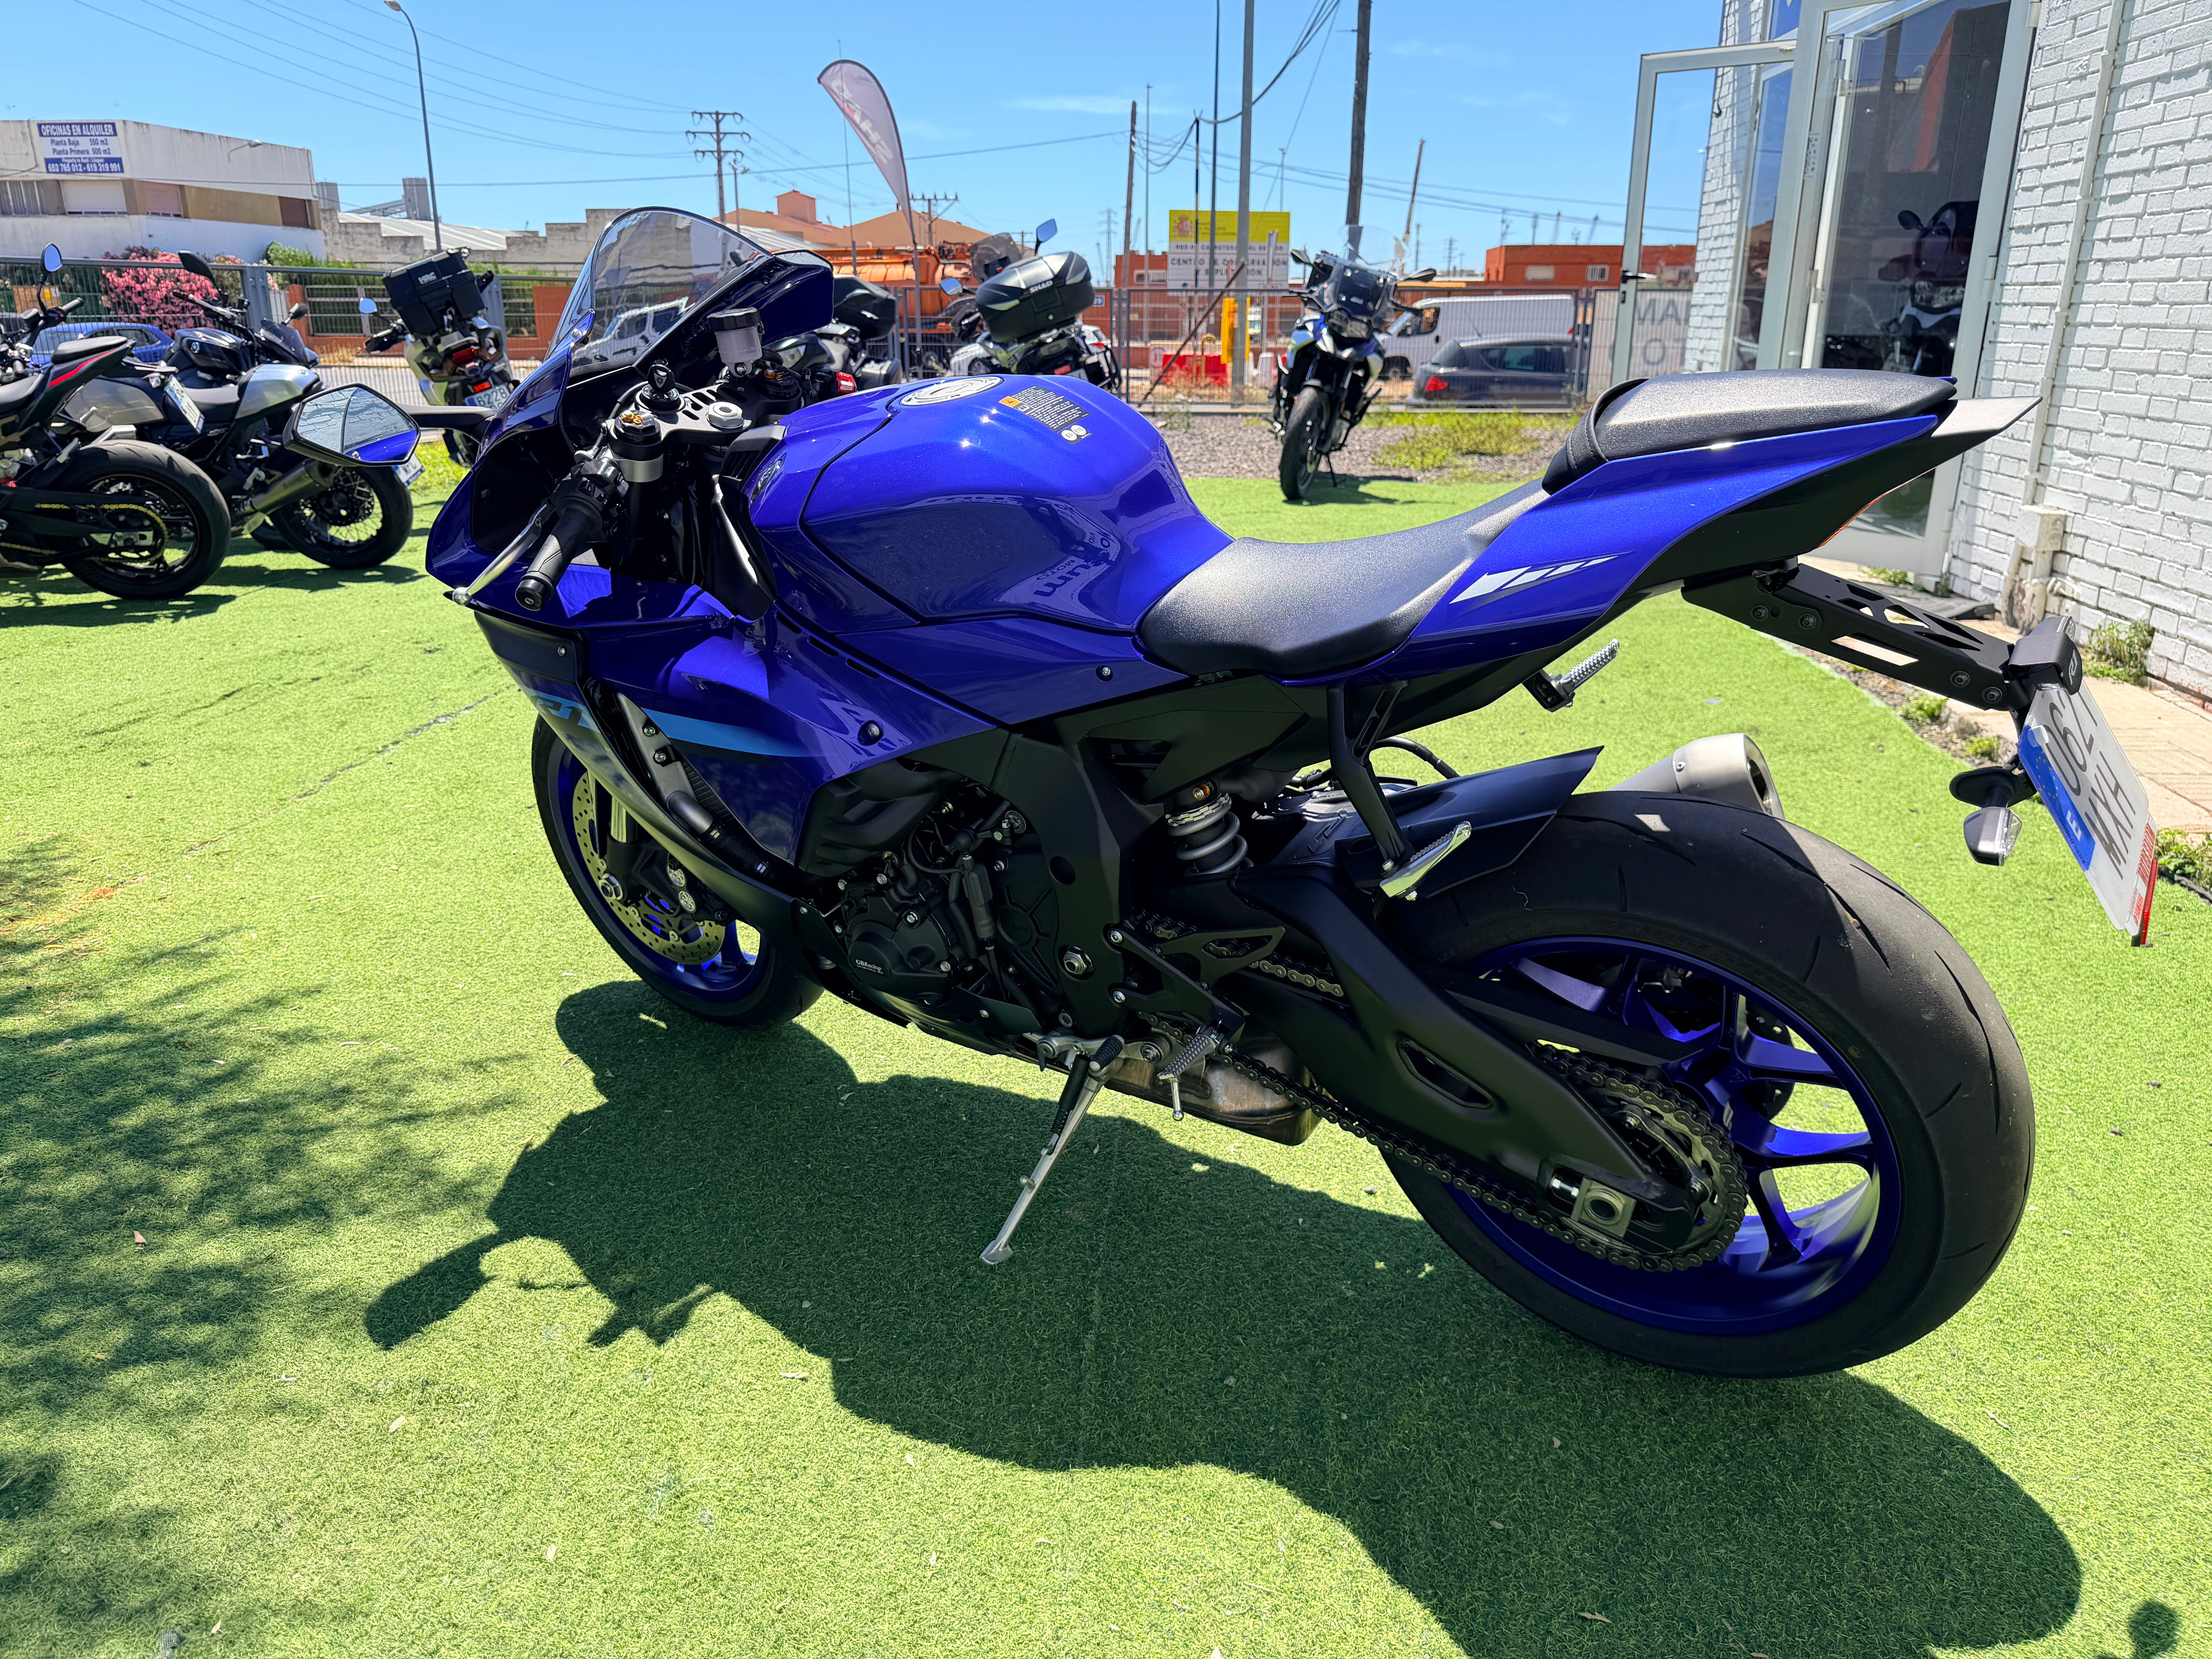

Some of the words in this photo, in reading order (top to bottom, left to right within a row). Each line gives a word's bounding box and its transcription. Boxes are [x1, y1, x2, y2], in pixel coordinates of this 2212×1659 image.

[41, 125, 71, 136] OFICINAS
[71, 125, 81, 135] EN
[82, 124, 114, 135] ALQUILER
[68, 138, 79, 147] Baja
[48, 163, 59, 172] 653
[60, 163, 70, 172] 765
[71, 163, 83, 172] 012
[86, 163, 98, 172] 619
[98, 163, 109, 172] 319
[109, 163, 121, 172] 991
[1029, 280, 1053, 293] SHAD
[476, 387, 508, 407] 6228
[1036, 559, 1076, 580] MOTO
[2066, 810, 2081, 841] E
[855, 959, 883, 972] GBRacing
